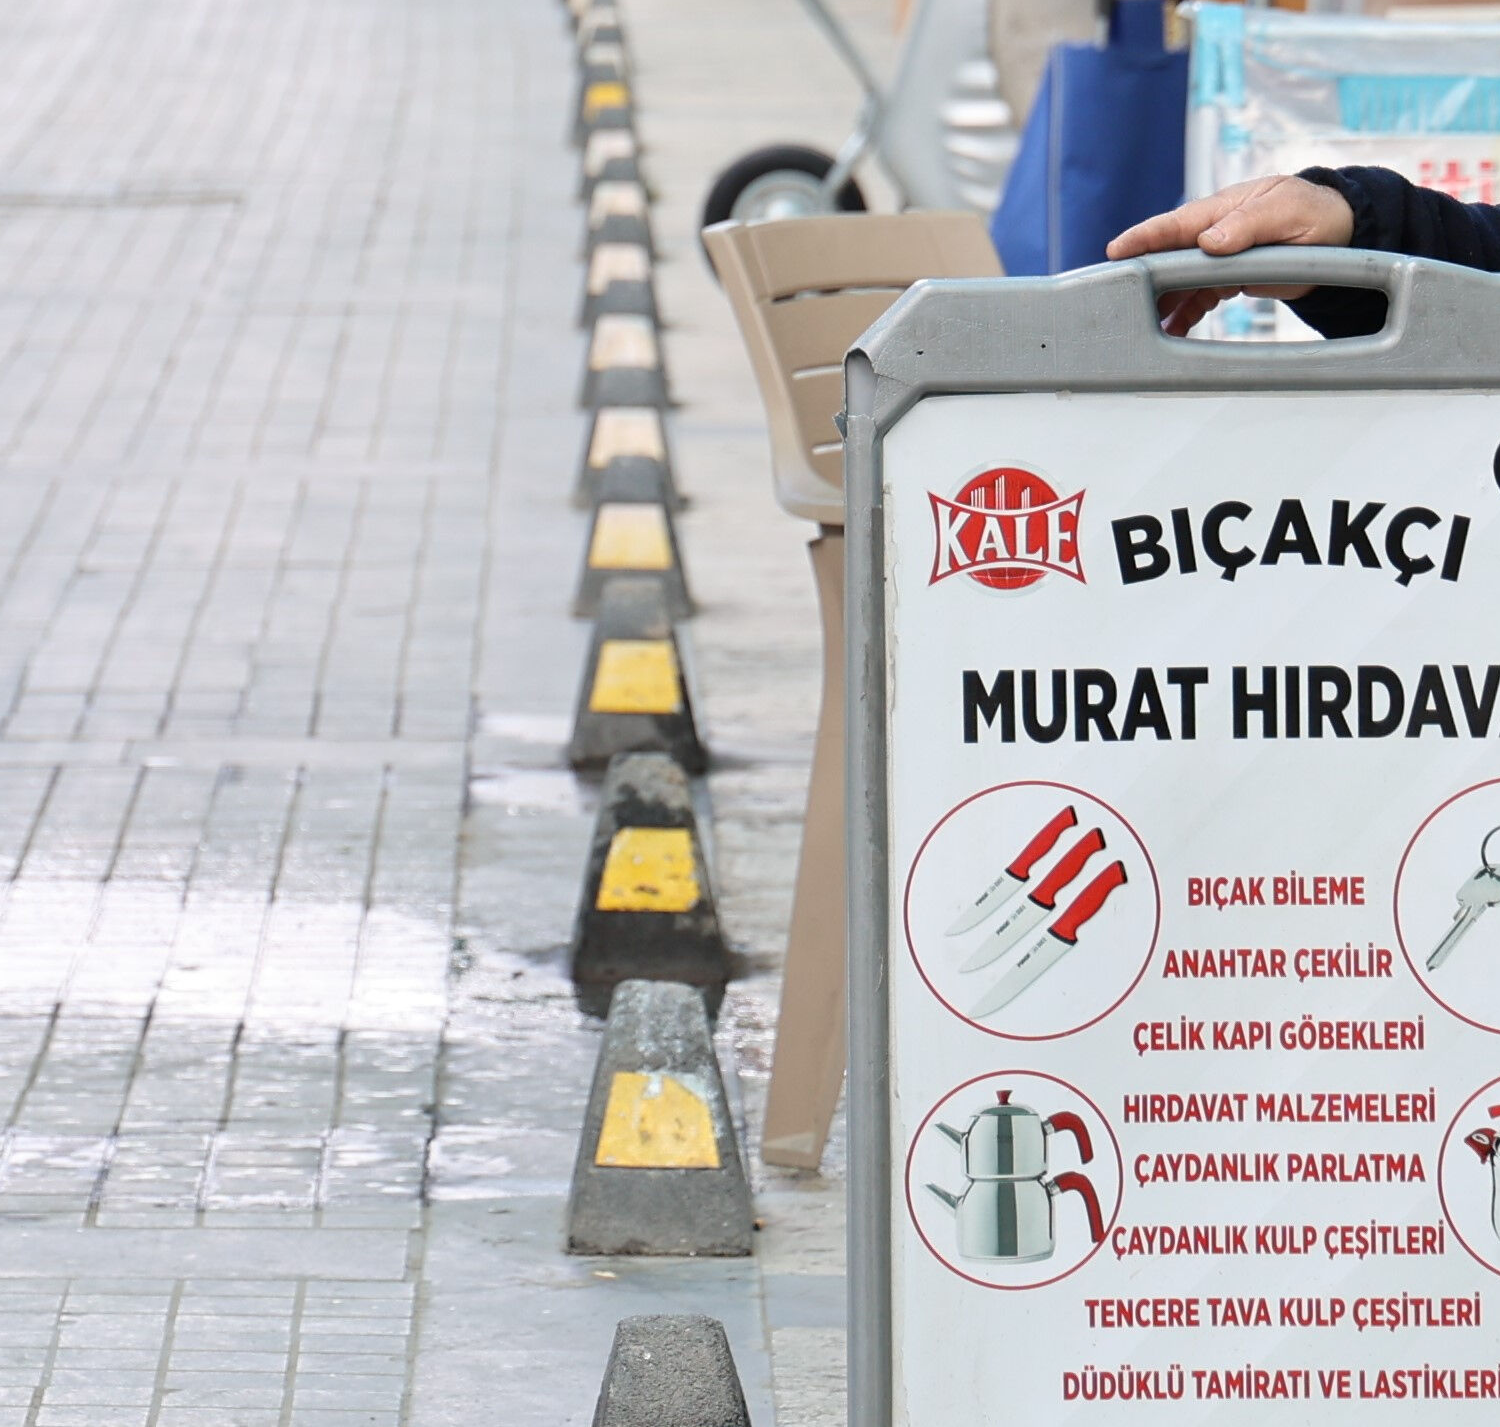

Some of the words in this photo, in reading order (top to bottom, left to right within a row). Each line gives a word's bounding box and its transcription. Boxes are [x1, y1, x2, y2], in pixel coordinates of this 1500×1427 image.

[936, 493, 1080, 568] KALE
[1111, 499, 1471, 588] BIÇAKÇI
[963, 667, 1208, 743] MURAT
[1187, 876, 1265, 911] BIÇAK
[1273, 870, 1365, 906] BİLEME
[1163, 948, 1286, 979] ANAHTAR
[1294, 942, 1393, 982] ÇEKİLİR
[1133, 1015, 1205, 1056] ÇELİK
[1213, 1021, 1272, 1050] KAPI
[1280, 1014, 1425, 1050] GÖBEKLERİ
[1124, 1094, 1248, 1123] HIRDAVAT
[1256, 1087, 1436, 1123] MALZEMELERİ
[1134, 1154, 1279, 1188] ÇAYDANLIK
[1287, 1153, 1426, 1182] PARLATMA
[1112, 1225, 1248, 1260] ÇAYDANLIK
[1255, 1225, 1317, 1255] KULP
[1324, 1219, 1445, 1260] ÇEŞİTLERİ
[1085, 1298, 1200, 1328] TENCERE
[1207, 1298, 1272, 1327] TAVA
[1279, 1298, 1345, 1326] KULP
[1353, 1291, 1481, 1332] ÇEŞİTLERİ
[1063, 1365, 1184, 1401] DÜDÜKLÜ
[1192, 1364, 1311, 1400] TAMİRATI
[1318, 1371, 1352, 1400] VE
